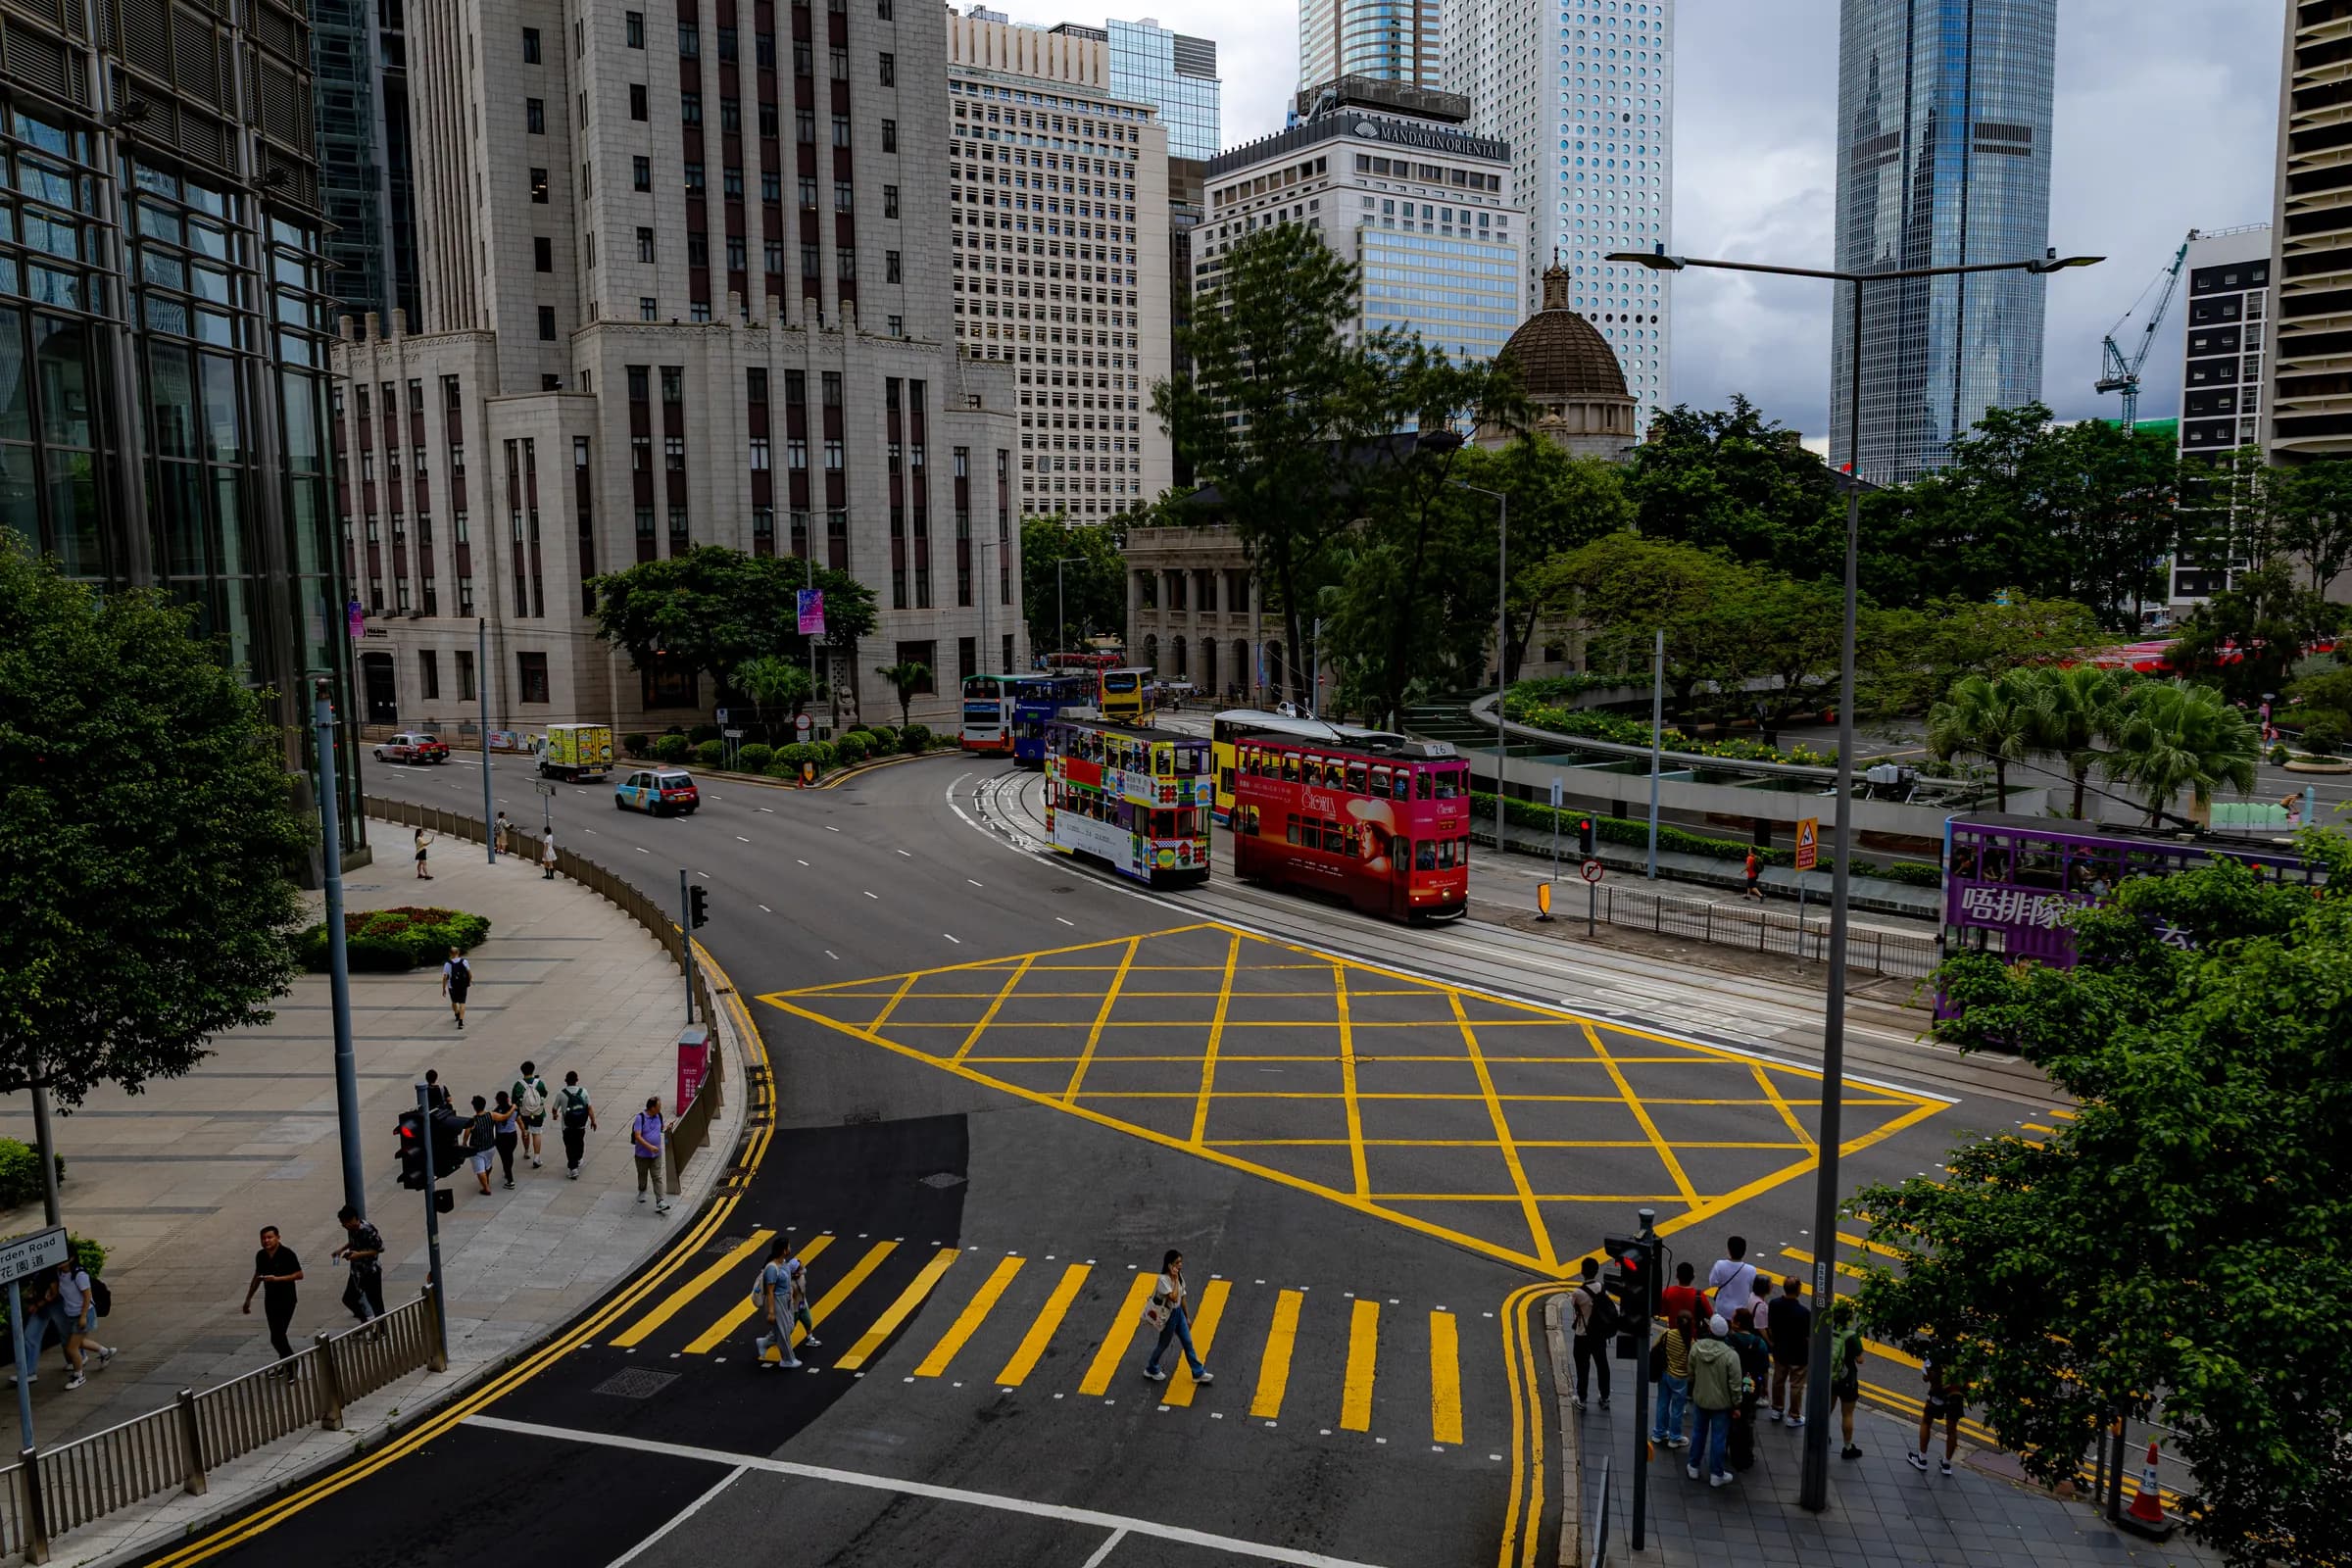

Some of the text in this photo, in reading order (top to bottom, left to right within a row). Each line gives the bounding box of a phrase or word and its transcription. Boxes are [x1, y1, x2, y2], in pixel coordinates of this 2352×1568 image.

[1381, 126, 1501, 159] MANDARIN ORIENTAL
[1433, 745, 1446, 755] 26
[28, 1237, 56, 1253] Road
[0, 1254, 44, 1278] 花園道
